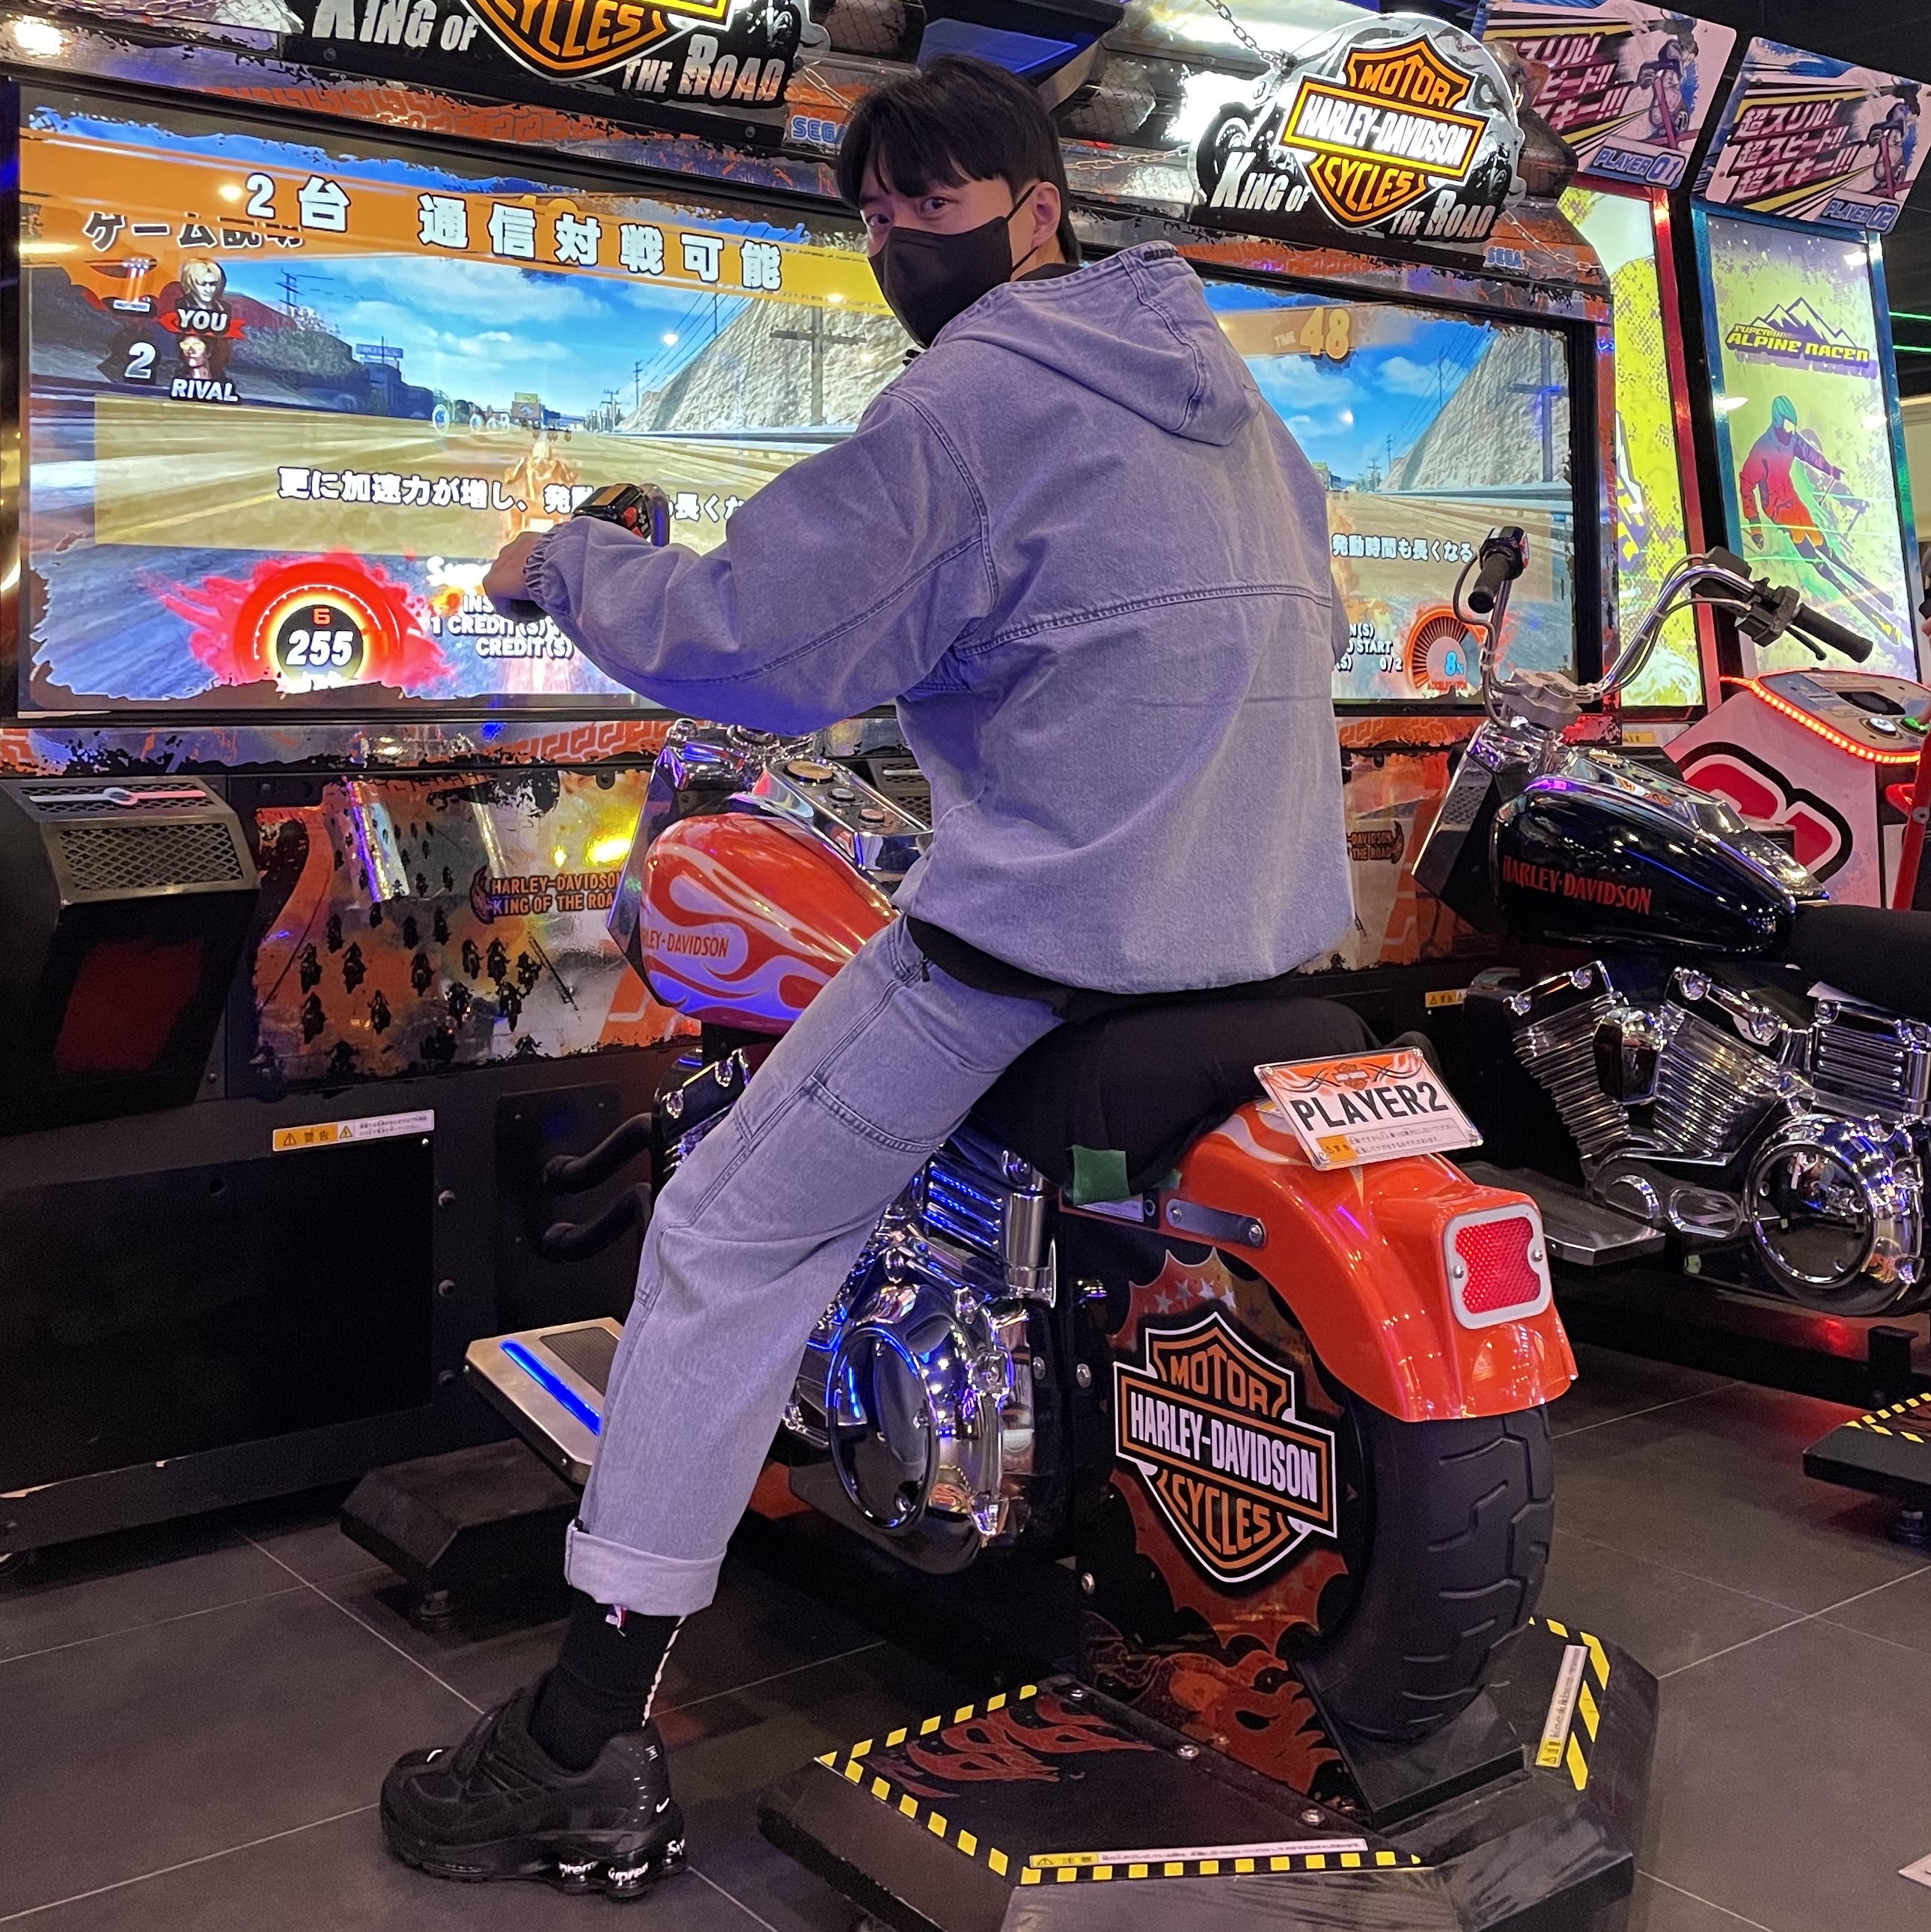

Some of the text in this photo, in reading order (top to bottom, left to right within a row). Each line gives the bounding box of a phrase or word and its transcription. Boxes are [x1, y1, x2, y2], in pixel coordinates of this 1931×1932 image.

[622, 34, 786, 101] THE ROAD
[1359, 54, 1451, 107] MOTOR
[1297, 95, 1474, 166] HARLEY-DAVIDSON
[1323, 155, 1415, 212] CYCLES
[1593, 149, 1683, 183] PLAYER 01
[1390, 189, 1497, 238] THE ROAD
[1822, 200, 1899, 229] PLAYER 02
[1486, 247, 1524, 269] SEGA
[177, 308, 228, 332] YOU
[1274, 306, 1350, 359] TIME 48
[1727, 332, 1802, 353] ALPINE
[124, 341, 156, 380] 2
[171, 379, 239, 403] RIVAL
[313, 608, 331, 625] 6
[463, 594, 495, 614] INS
[430, 616, 442, 636] 1
[285, 630, 354, 666] 255
[476, 638, 575, 659] CREDIT(S)
[1357, 640, 1393, 655] START
[1352, 847, 1368, 860] THE
[1503, 855, 1653, 915] HARLEY-DAVIDSON
[492, 892, 614, 915] KING OF THE ROA
[1290, 1081, 1449, 1132] PLAYER2
[1170, 1344, 1269, 1416] MOTOR
[1130, 1391, 1318, 1503] HARLEY-DAVIDSON
[1172, 1472, 1272, 1555] CYCLES
